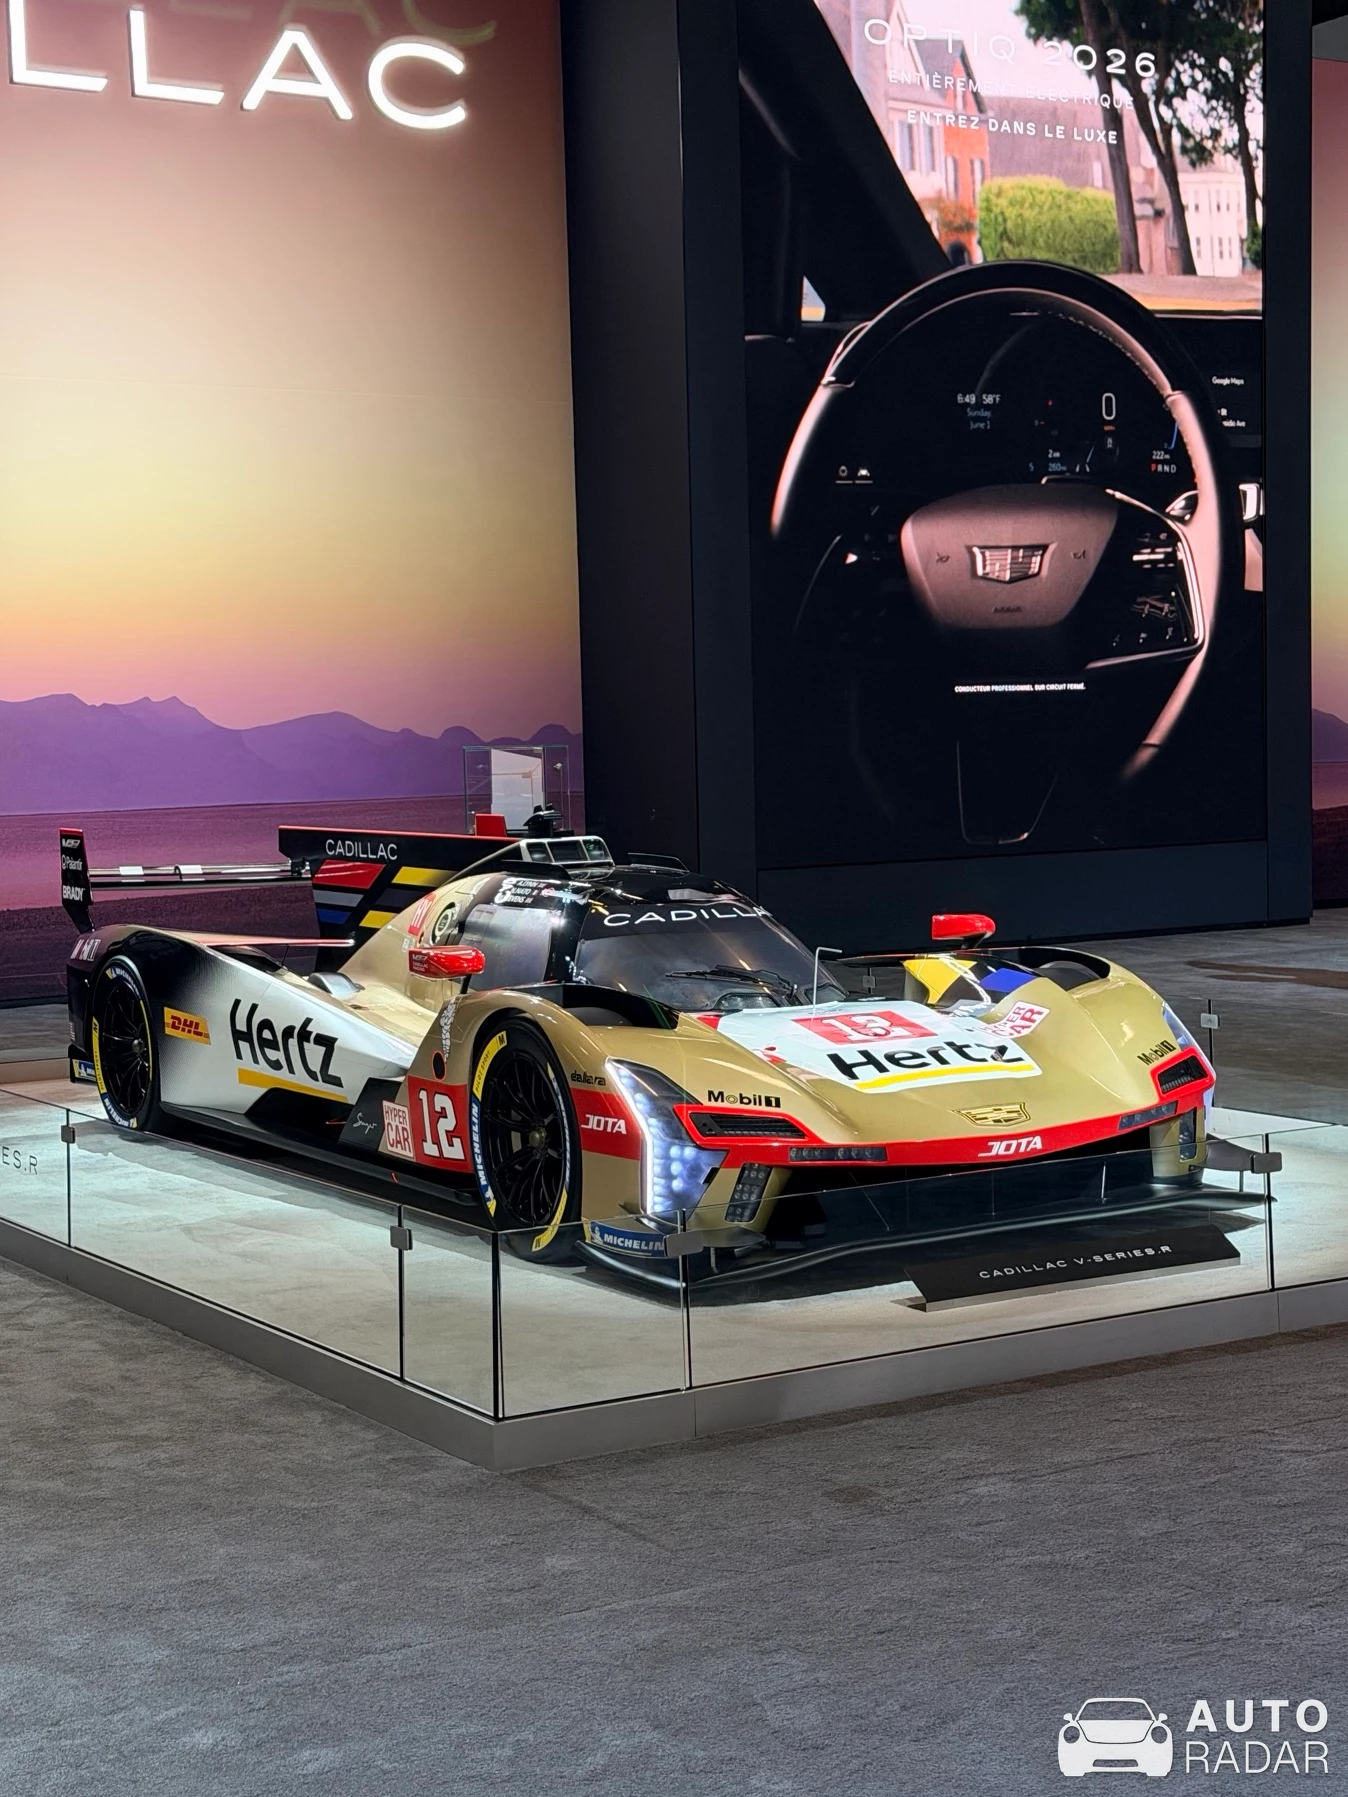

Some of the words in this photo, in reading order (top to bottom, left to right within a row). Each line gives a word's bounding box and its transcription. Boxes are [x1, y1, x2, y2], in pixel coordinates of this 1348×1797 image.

[864, 18, 1015, 65] OPTIQ
[1042, 41, 1156, 78] 2026
[9, 0, 466, 130] LLAC
[907, 110, 980, 130] ENTREZ
[988, 118, 1036, 136] DANS
[1044, 125, 1066, 139] LE
[1073, 128, 1118, 145] LUXE
[955, 685, 991, 693] CONDUCTEUR
[325, 839, 398, 861] CADILLAC
[170, 1014, 204, 1037] DHL
[991, 1007, 1045, 1037] CAR
[229, 998, 344, 1089] Hertz
[1136, 1043, 1169, 1066] Mobil
[827, 1040, 1025, 1080] Hertz
[570, 1069, 607, 1087] dallara
[707, 1090, 763, 1107] Mobil
[384, 1105, 408, 1126] HYPER
[419, 1088, 466, 1161] 12
[580, 1113, 628, 1136] JOTA
[386, 1121, 412, 1153] CAR
[471, 1103, 487, 1186] MICHELIN
[977, 1135, 1043, 1158] JOTA
[2, 1145, 38, 1176] ES.R
[603, 1233, 665, 1251] MICHELIN
[979, 1259, 1068, 1279] CADILLAC
[1073, 1245, 1173, 1266] V-SERIES.R
